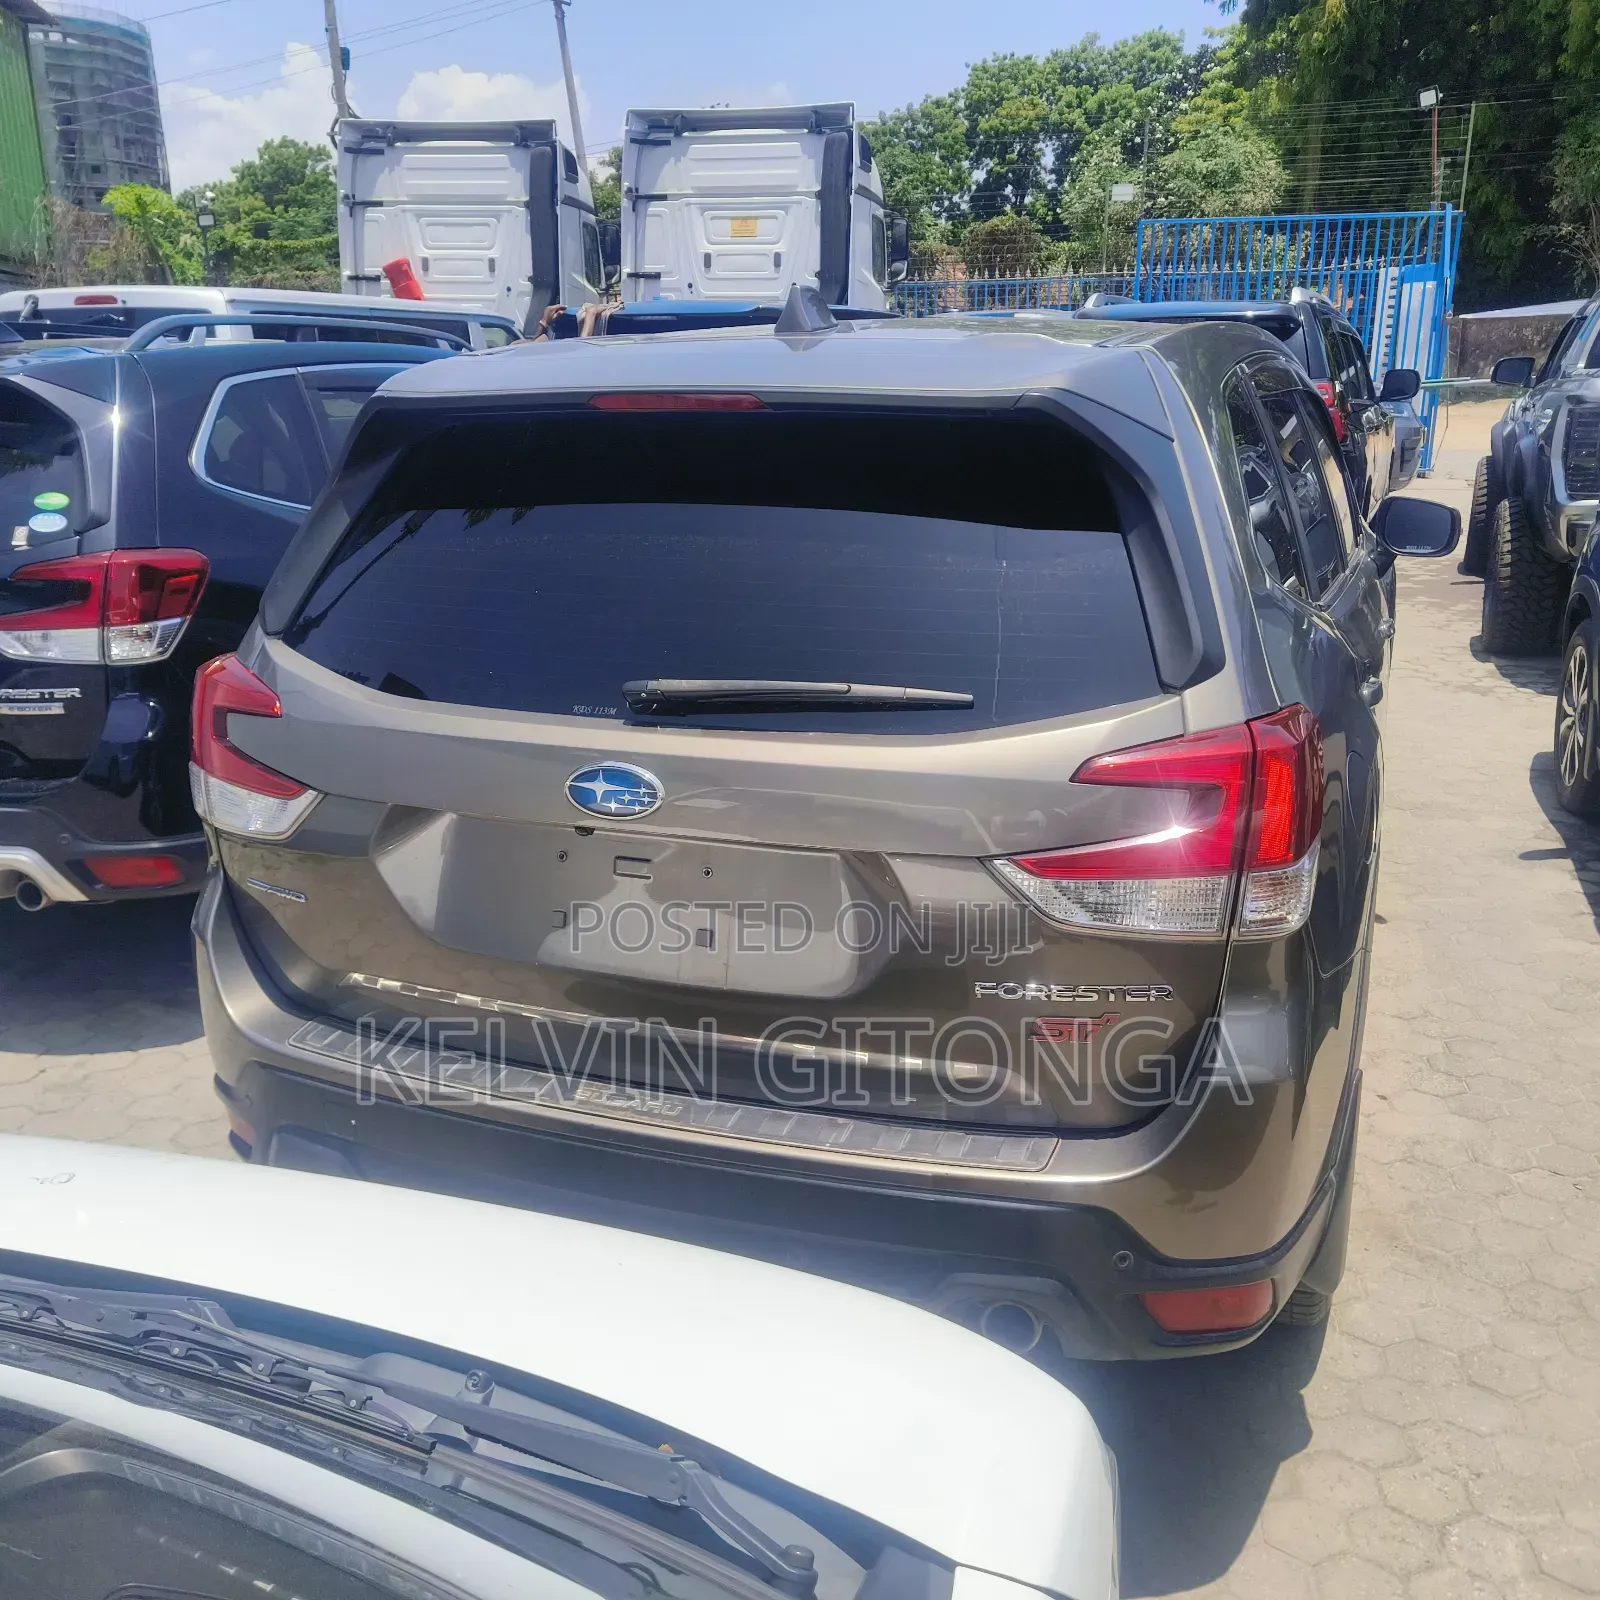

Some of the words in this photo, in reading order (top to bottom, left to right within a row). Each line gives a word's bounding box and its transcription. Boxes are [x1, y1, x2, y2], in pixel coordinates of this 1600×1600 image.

[572, 704, 593, 714] KDS
[974, 981, 1174, 1002] FORESTER
[574, 1088, 683, 1117] SUBARU
